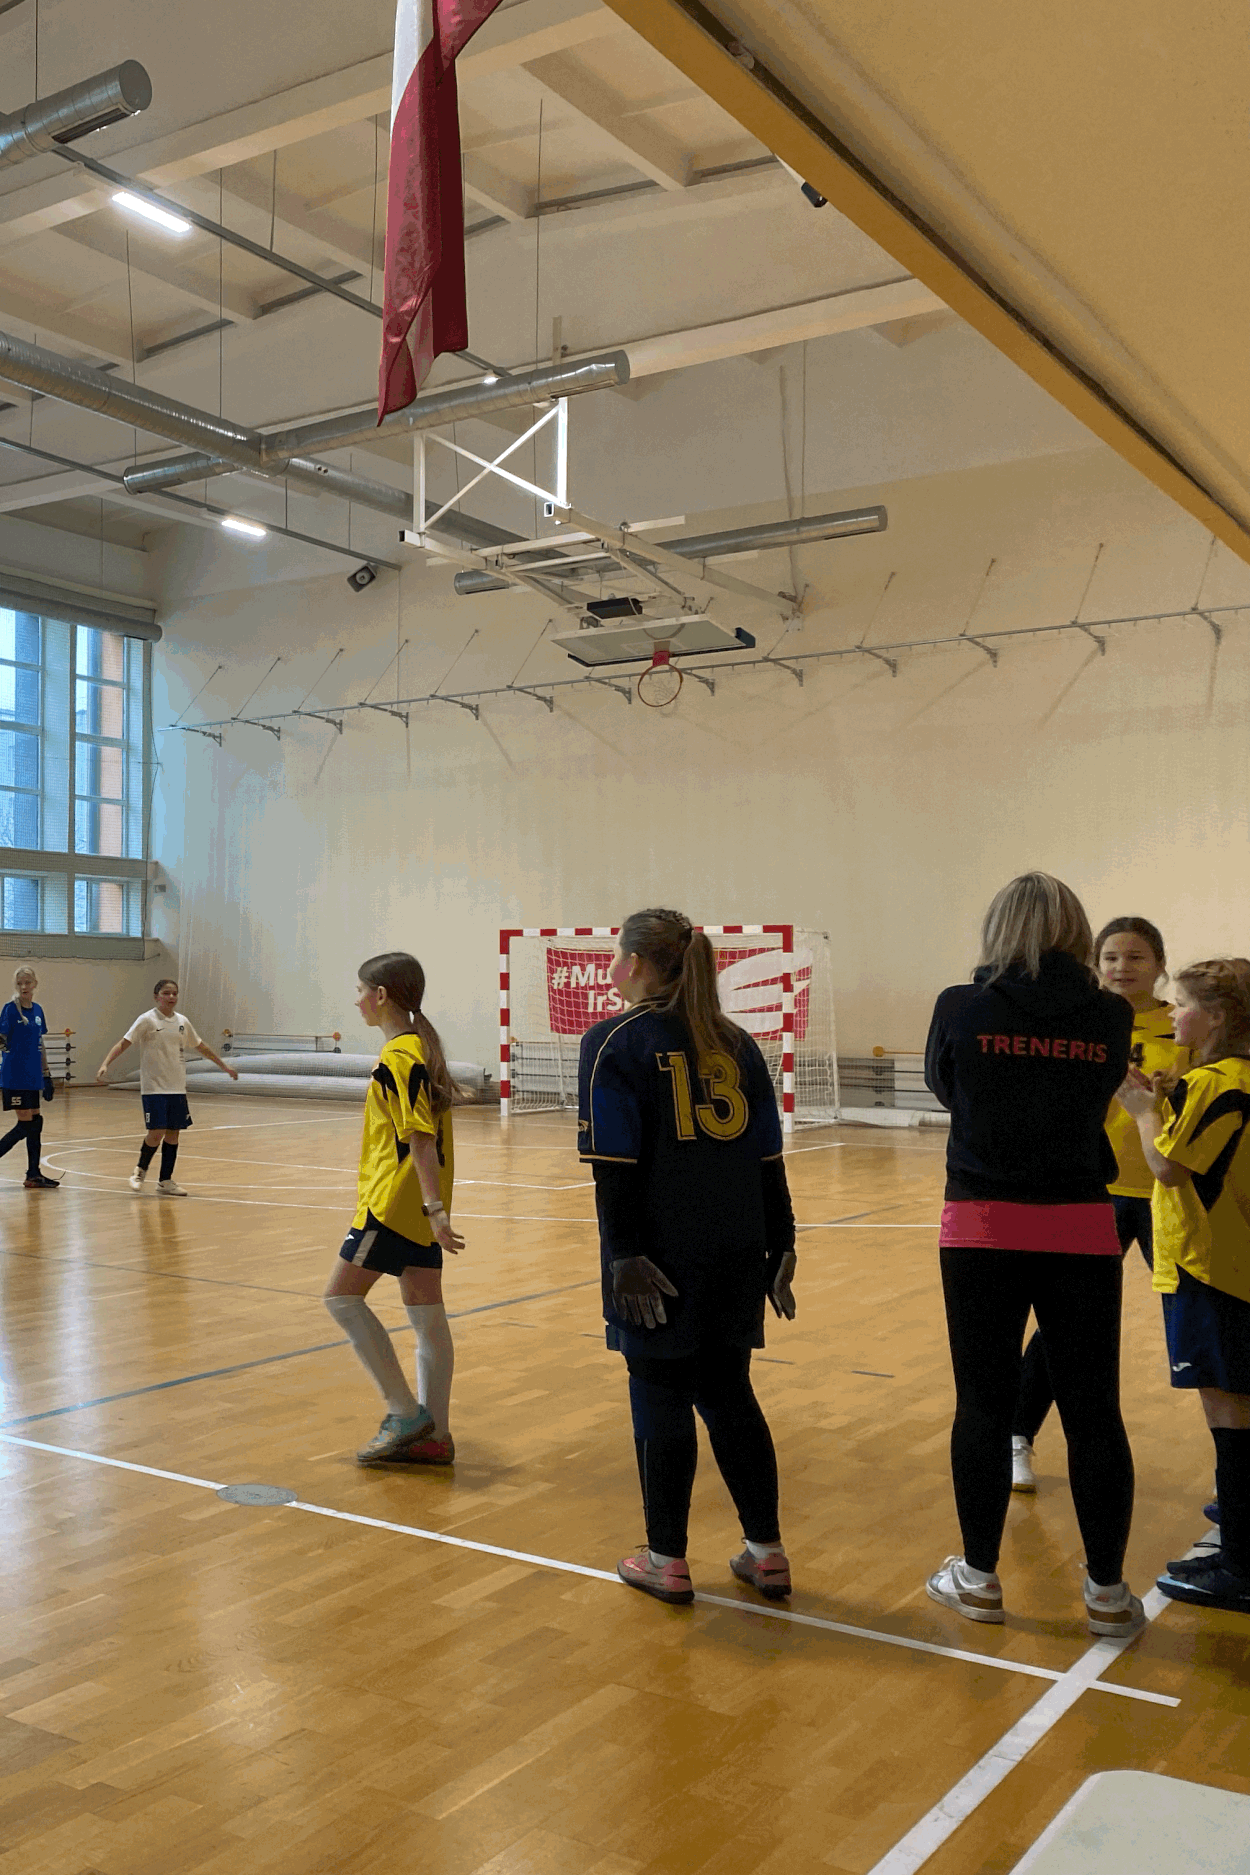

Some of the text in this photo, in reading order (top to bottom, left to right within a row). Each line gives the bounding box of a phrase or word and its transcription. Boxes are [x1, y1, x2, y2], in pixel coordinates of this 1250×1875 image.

[551, 964, 612, 990] #Mu
[976, 1035, 1107, 1063] TRENERIS
[656, 1051, 748, 1140] 13
